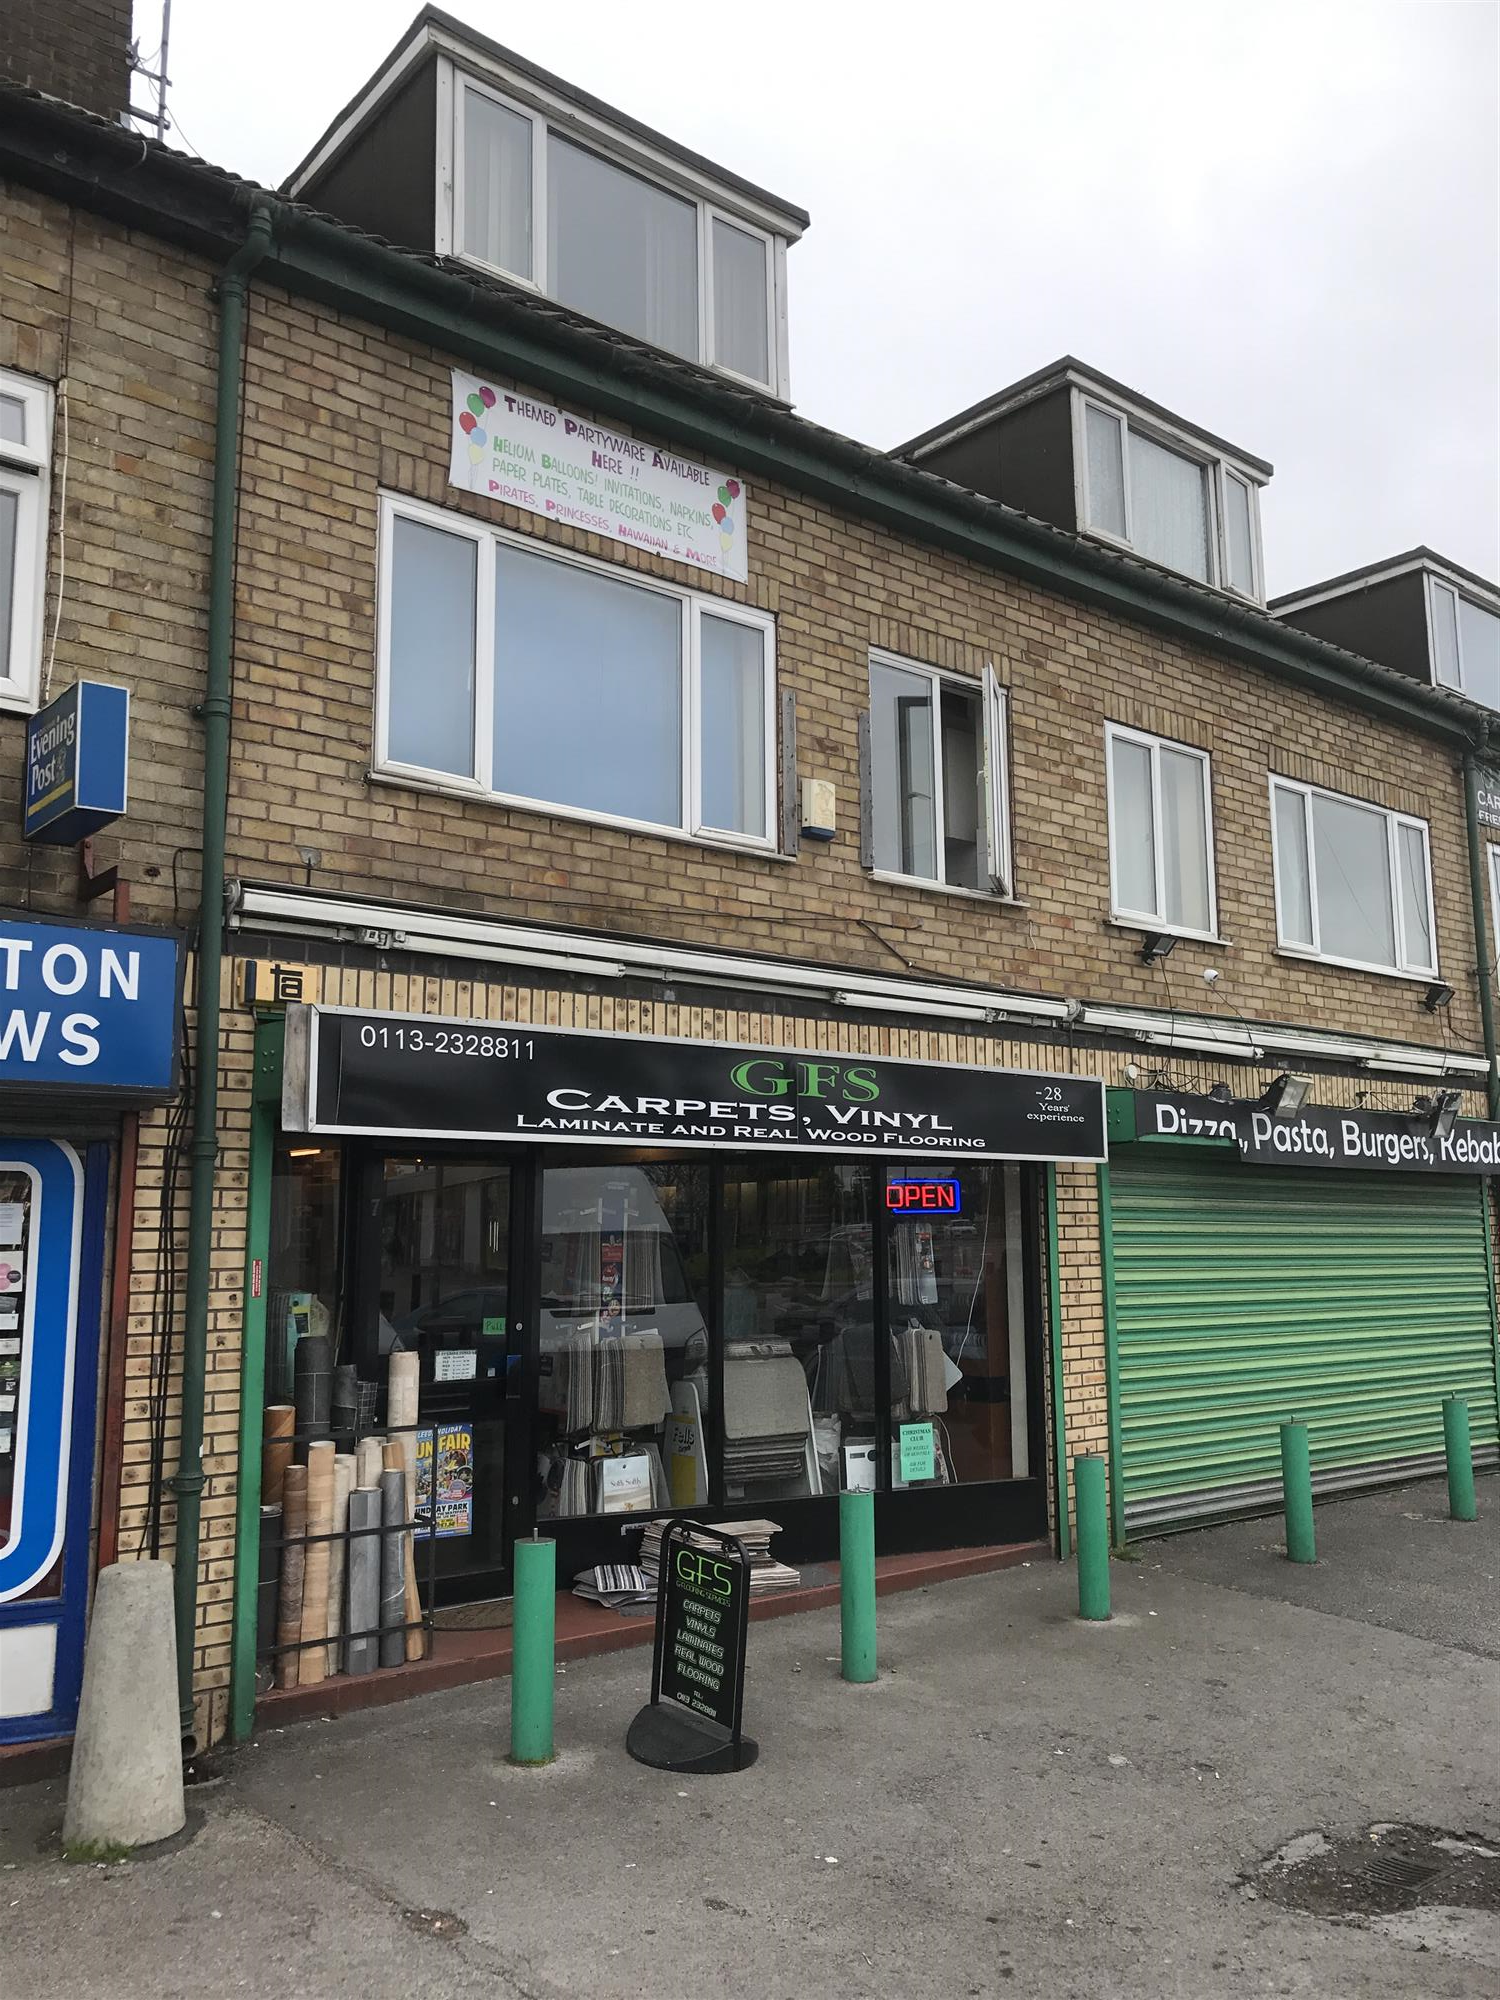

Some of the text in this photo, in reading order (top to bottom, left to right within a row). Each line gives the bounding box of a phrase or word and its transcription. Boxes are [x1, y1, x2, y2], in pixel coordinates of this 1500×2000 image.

[493, 435, 535, 464] HELIUM
[504, 395, 710, 486] THEMED PARTYWARE AVAILABLE
[592, 450, 623, 475] HERE
[492, 458, 526, 481] PAPER
[578, 487, 604, 509] TABLE
[609, 499, 671, 532] DECORATIONS
[685, 547, 717, 567] MORE
[31, 712, 75, 764] Evening
[31, 754, 56, 796] Post
[0, 937, 140, 1001] TON
[360, 1025, 535, 1060] 0113-2328811
[731, 1060, 880, 1102] GFS
[547, 1089, 953, 1131] CARPETS, VINYL
[1026, 1113, 1085, 1122] experience
[517, 1114, 986, 1148] LAMINATE AND REAL WOOD FLOORING
[1252, 1112, 1335, 1160] Pasta,
[1341, 1120, 1434, 1165] Burgers,
[887, 1185, 954, 1208] OPEN
[416, 1433, 471, 1459] UN FAIR
[448, 1502, 468, 1513] PARK
[677, 1550, 733, 1596] GFS
[683, 1599, 721, 1624] CARPETS
[674, 1643, 725, 1677] REAL WOOD
[676, 1628, 725, 1660] LAMINATES
[676, 1660, 720, 1692] FLOORING
